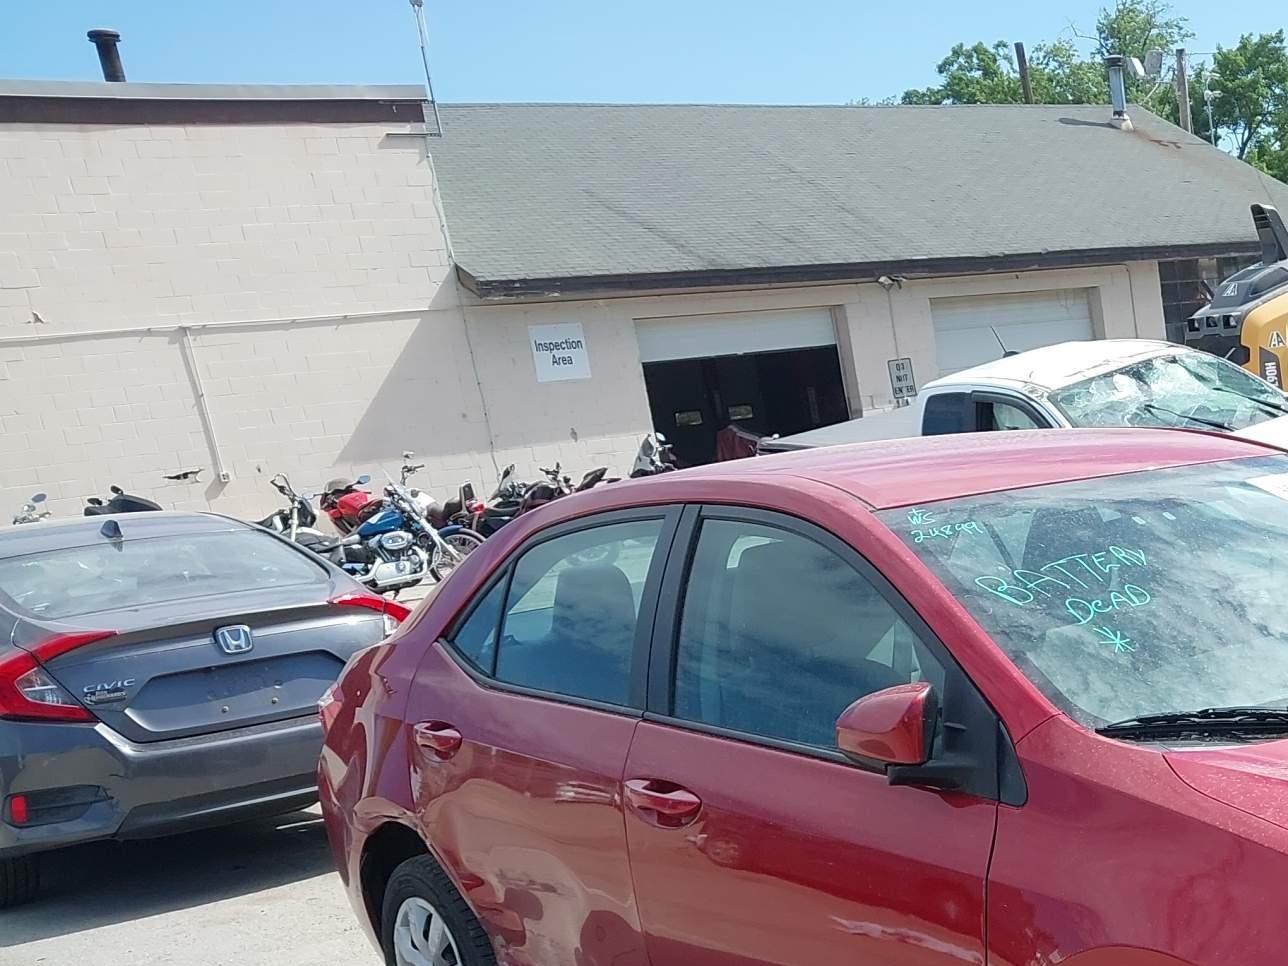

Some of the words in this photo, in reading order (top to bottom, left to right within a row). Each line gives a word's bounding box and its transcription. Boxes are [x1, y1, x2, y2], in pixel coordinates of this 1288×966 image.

[534, 338, 583, 353] Inspection
[551, 354, 573, 366] Area
[974, 545, 1147, 606] BATTERY
[83, 678, 136, 693] CIVIC
